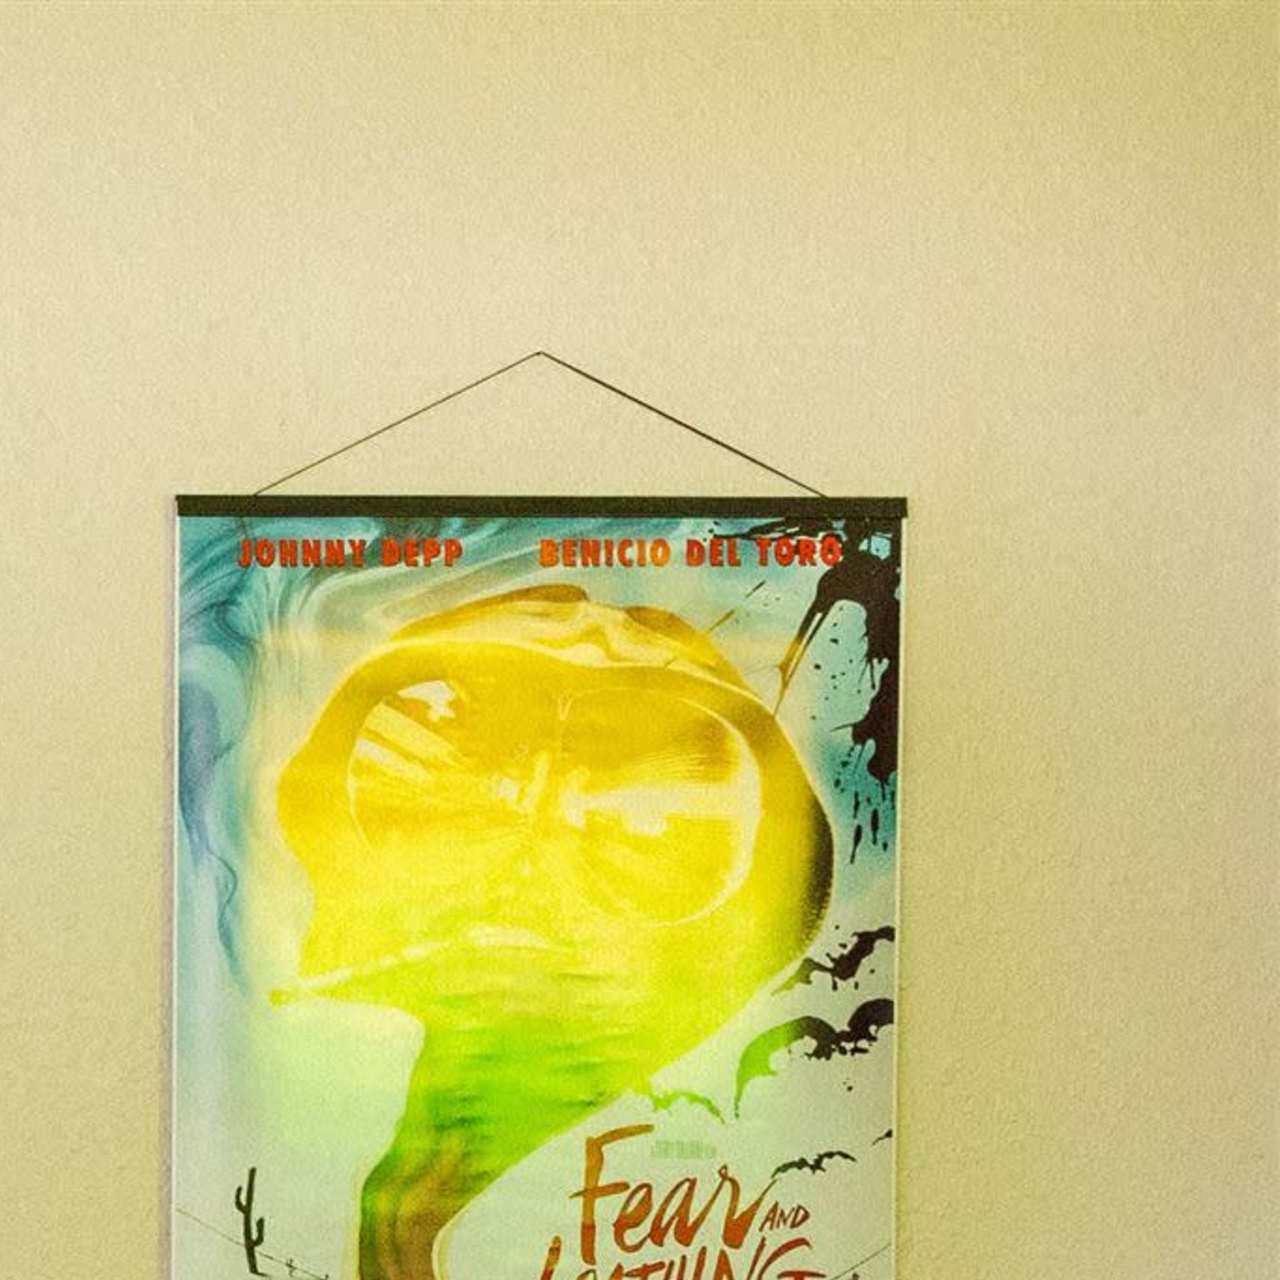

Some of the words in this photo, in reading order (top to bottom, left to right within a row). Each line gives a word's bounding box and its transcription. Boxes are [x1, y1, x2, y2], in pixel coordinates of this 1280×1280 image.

[238, 538, 367, 568] JOHNNY
[380, 538, 464, 567] DEPP
[538, 538, 671, 568] BENICIO
[685, 538, 740, 567] DEL
[755, 532, 842, 567] TORO
[568, 1123, 778, 1266] Fear
[758, 1201, 811, 1233] AND
